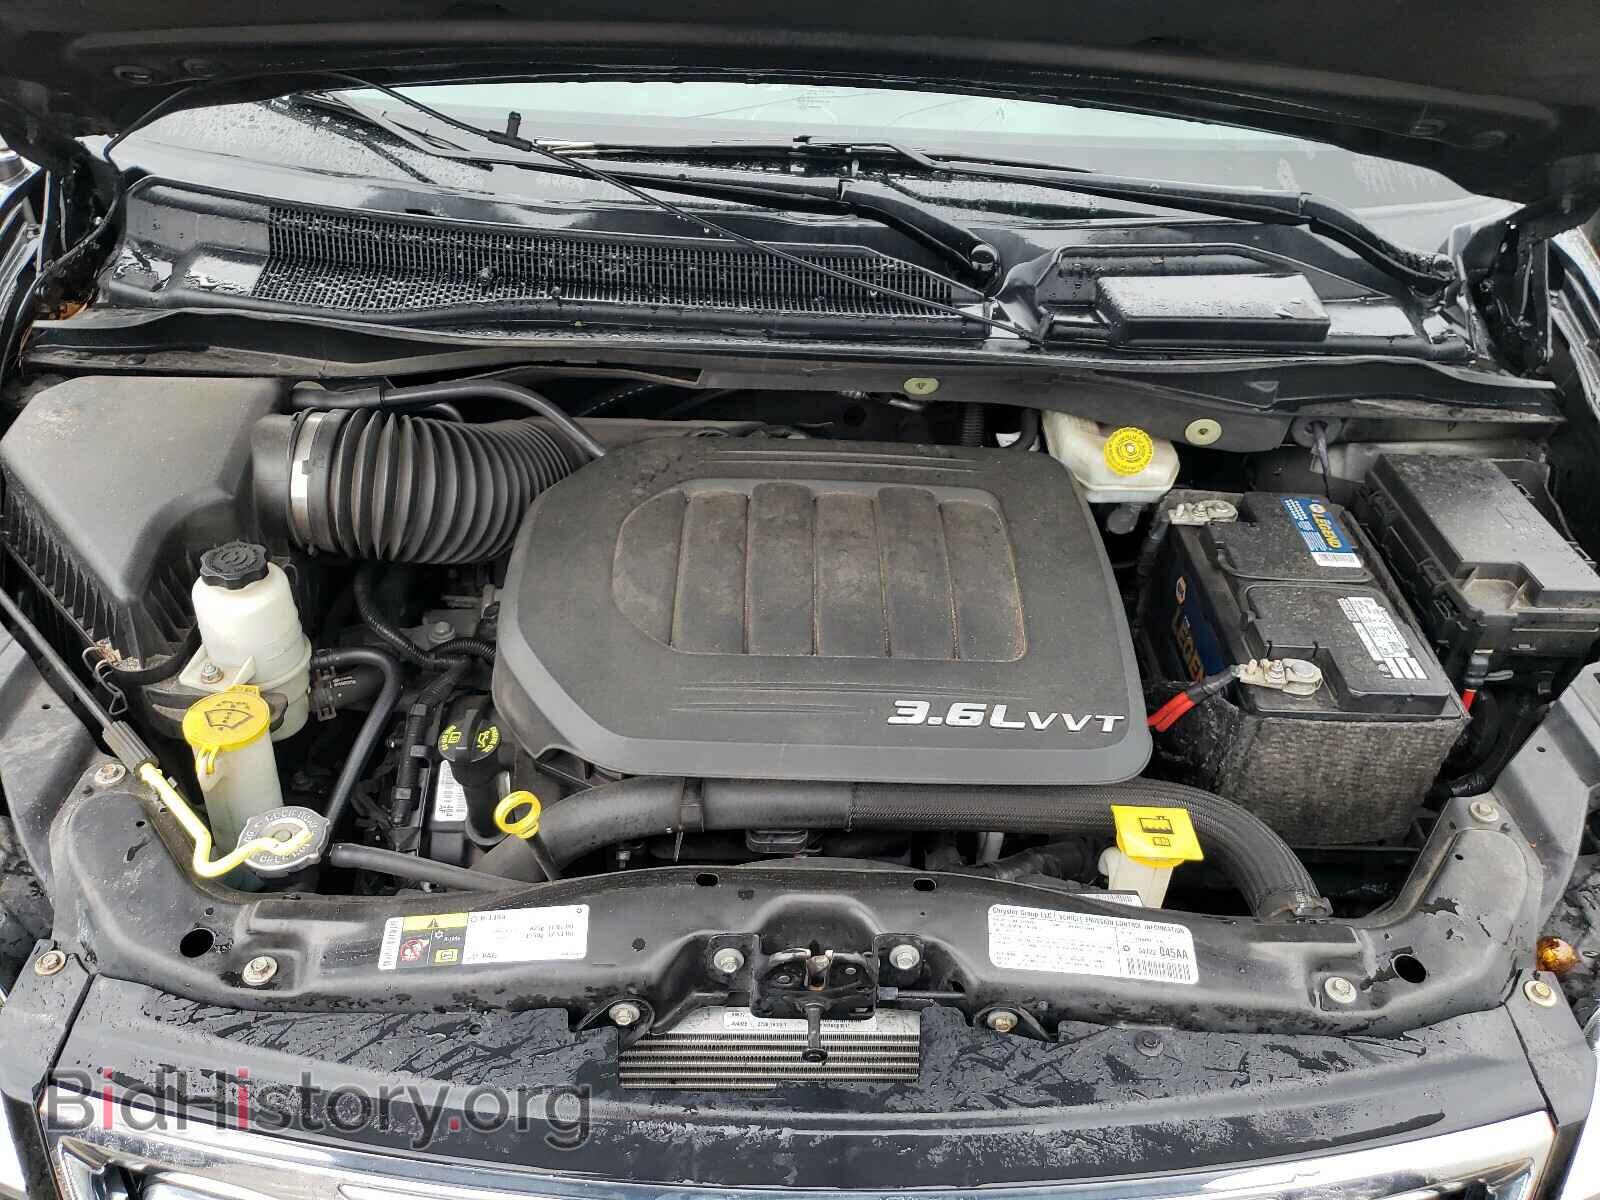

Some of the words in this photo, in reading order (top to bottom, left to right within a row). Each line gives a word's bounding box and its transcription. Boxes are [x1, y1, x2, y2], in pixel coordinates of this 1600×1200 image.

[1312, 513, 1343, 548] LEGEND
[887, 700, 1026, 730] 3.6L
[1027, 711, 1125, 732] VVT
[992, 906, 1019, 916] Chrysler
[1020, 909, 1039, 919] Group
